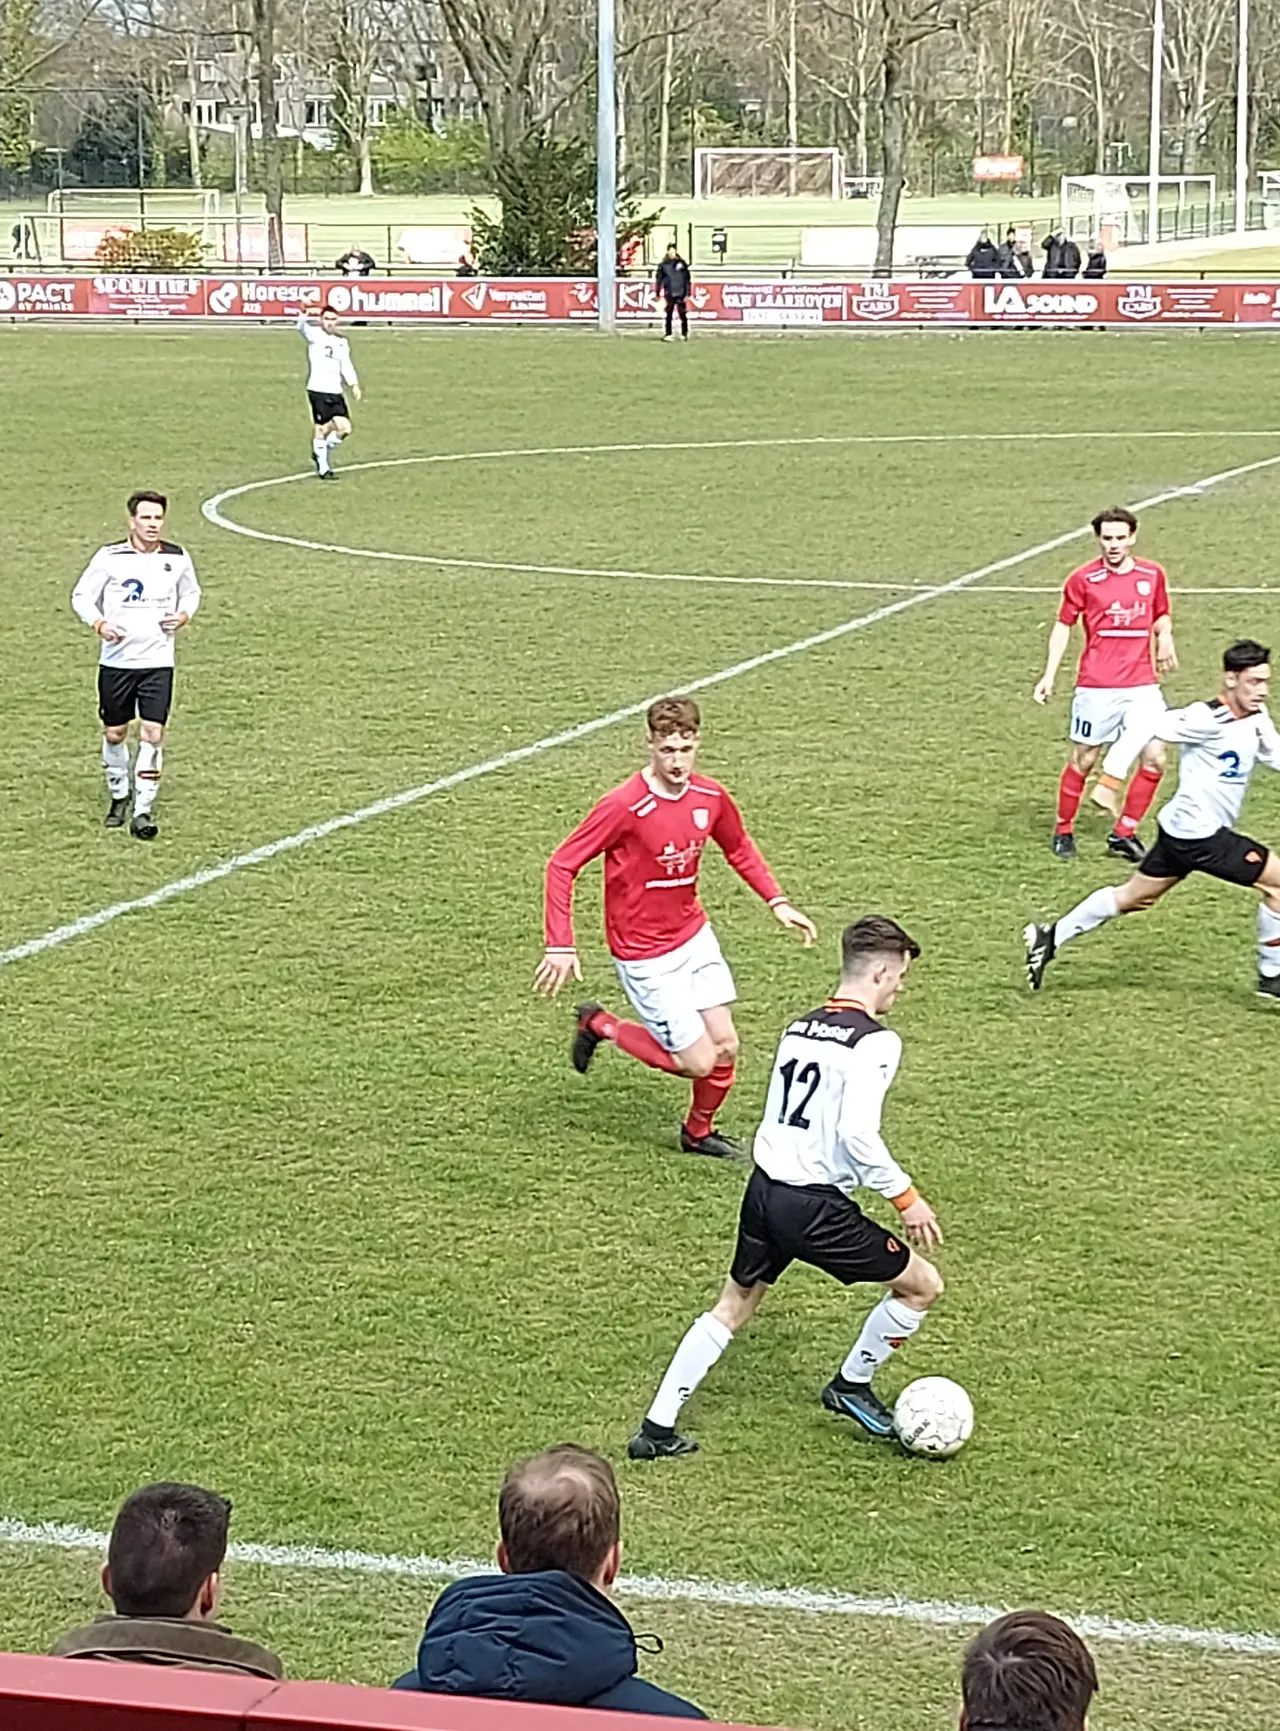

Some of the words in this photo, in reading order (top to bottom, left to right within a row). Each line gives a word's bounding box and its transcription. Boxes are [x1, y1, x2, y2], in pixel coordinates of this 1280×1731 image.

[17, 282, 75, 302] PACT
[241, 282, 321, 301] Horesca
[355, 285, 441, 313] hummel
[984, 285, 1023, 314] LA
[1025, 293, 1099, 314] SOUND
[1074, 715, 1093, 738] 10
[777, 1057, 822, 1130] 12
